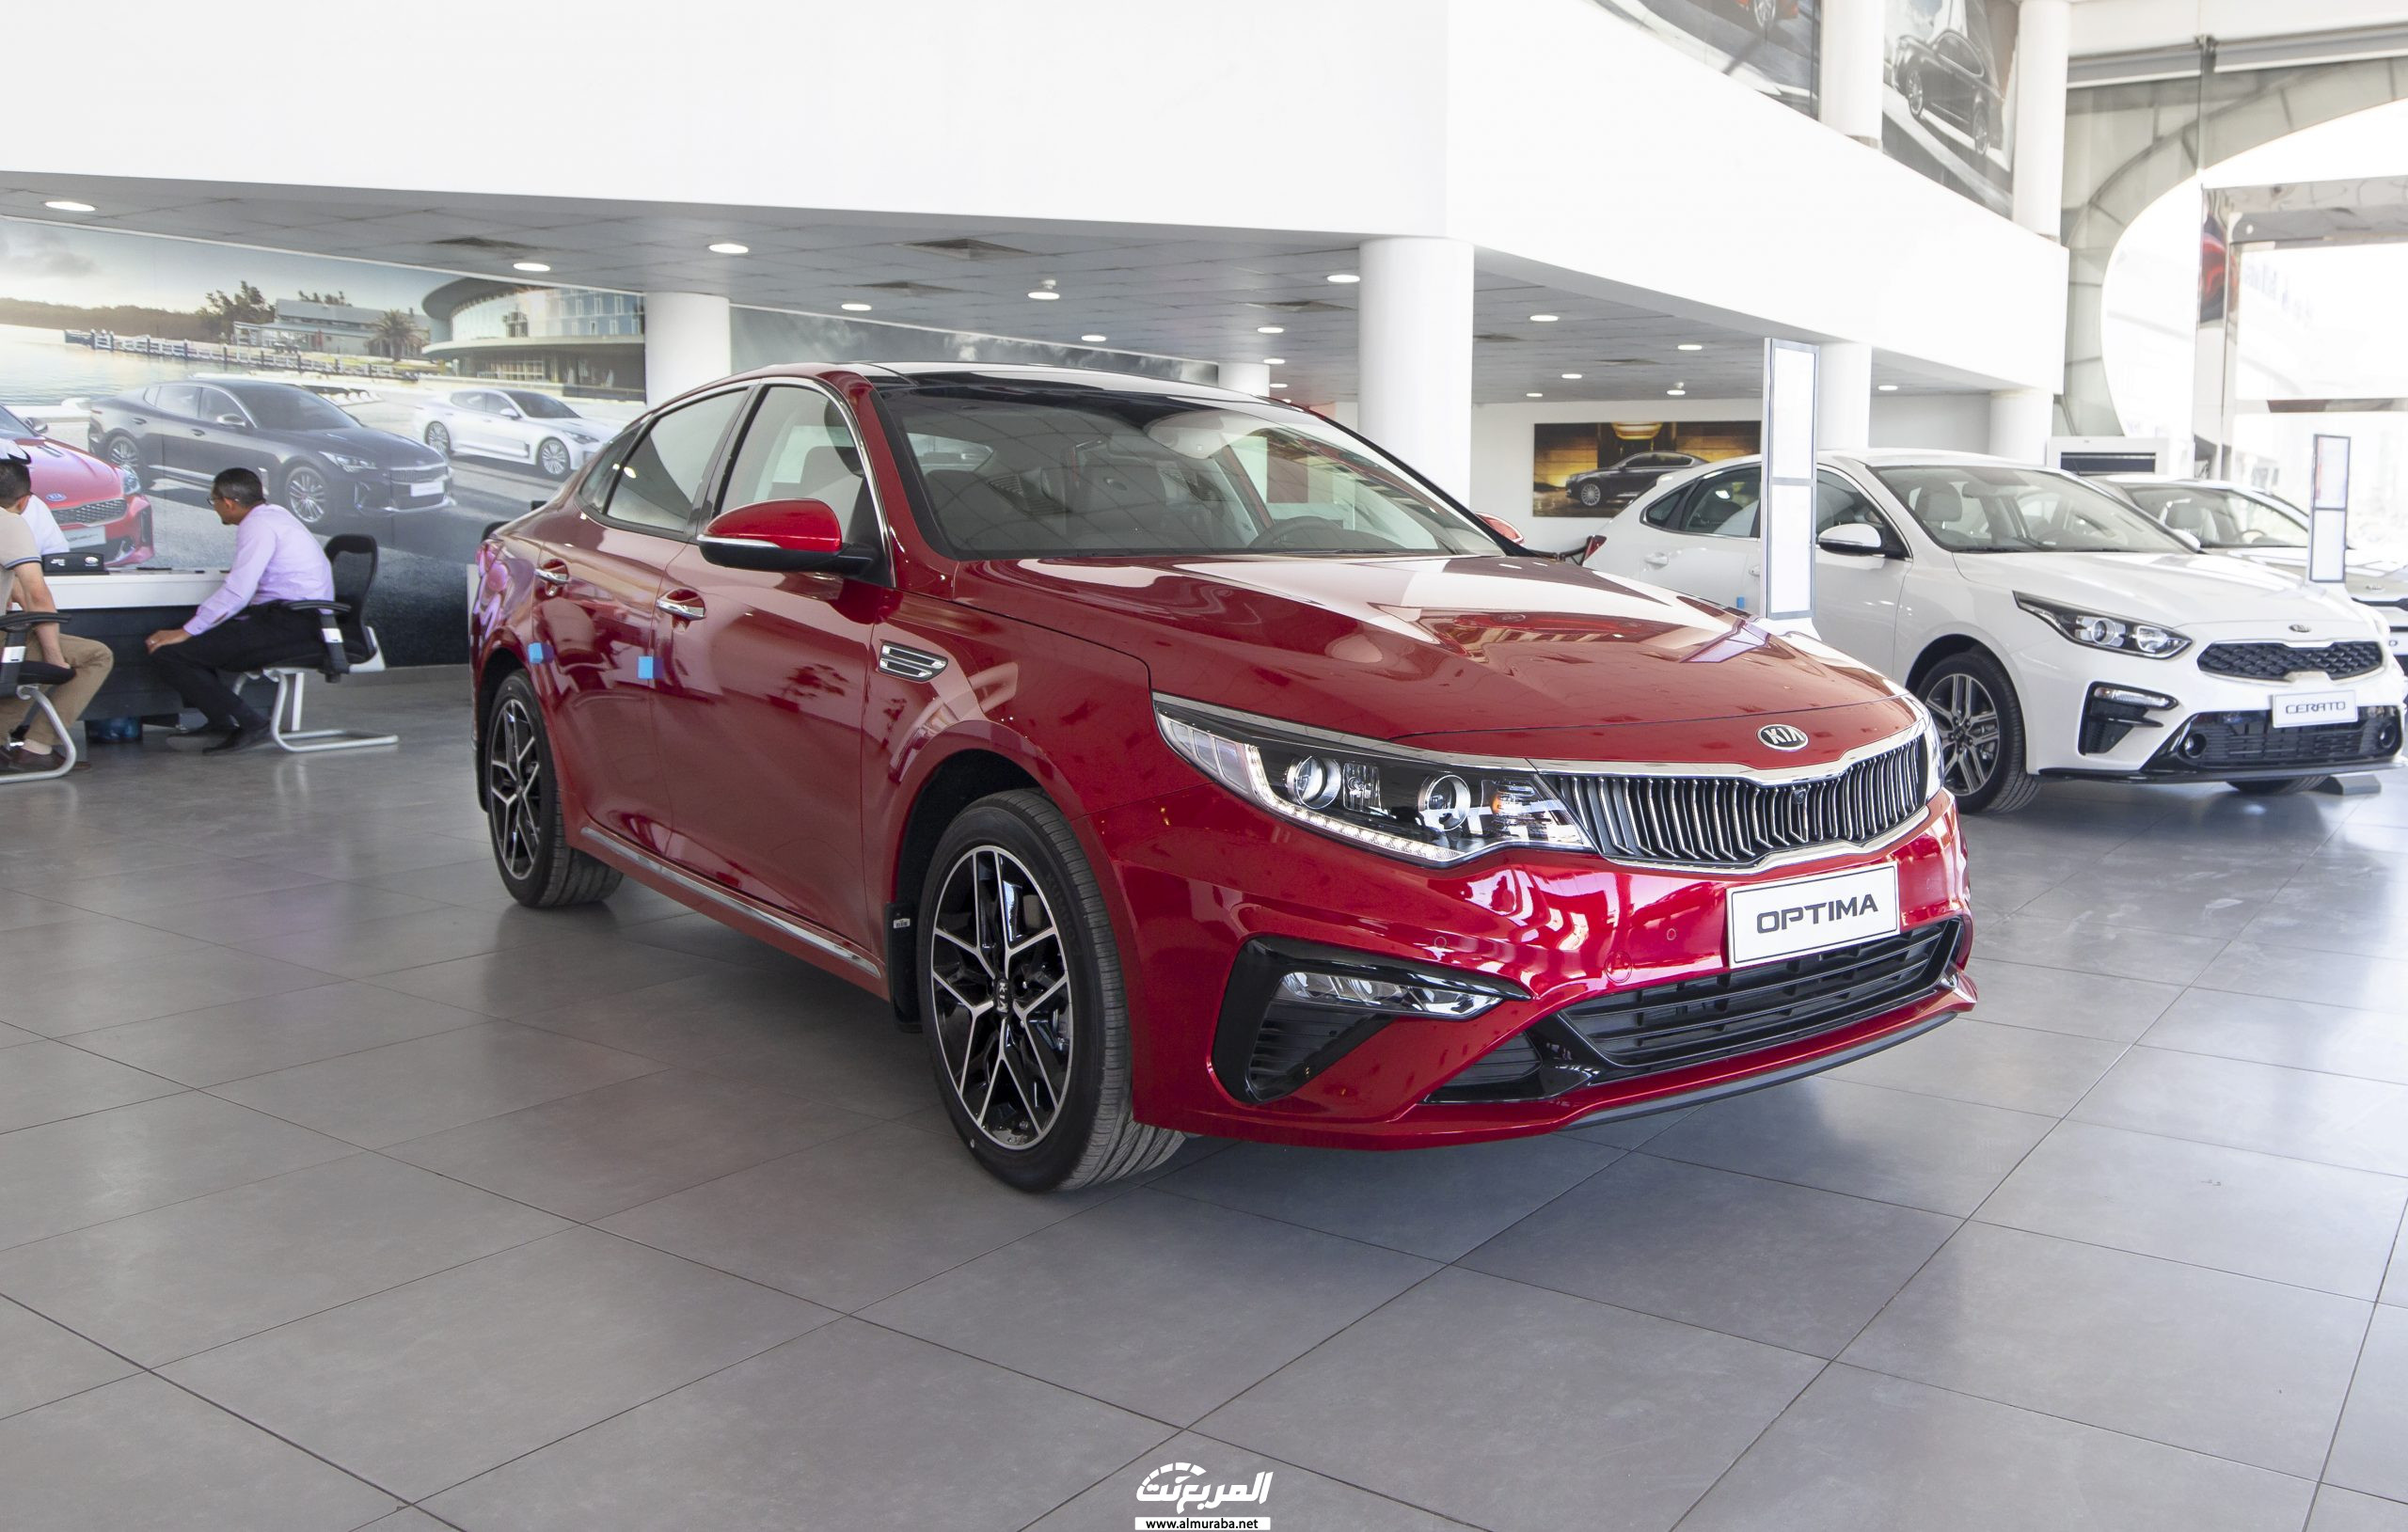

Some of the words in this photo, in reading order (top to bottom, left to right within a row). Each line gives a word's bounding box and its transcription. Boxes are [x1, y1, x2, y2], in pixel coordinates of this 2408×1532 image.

[2286, 701, 2346, 715] CERATO
[1765, 726, 1808, 746] KIA
[1756, 893, 1878, 934] OPTIMA
